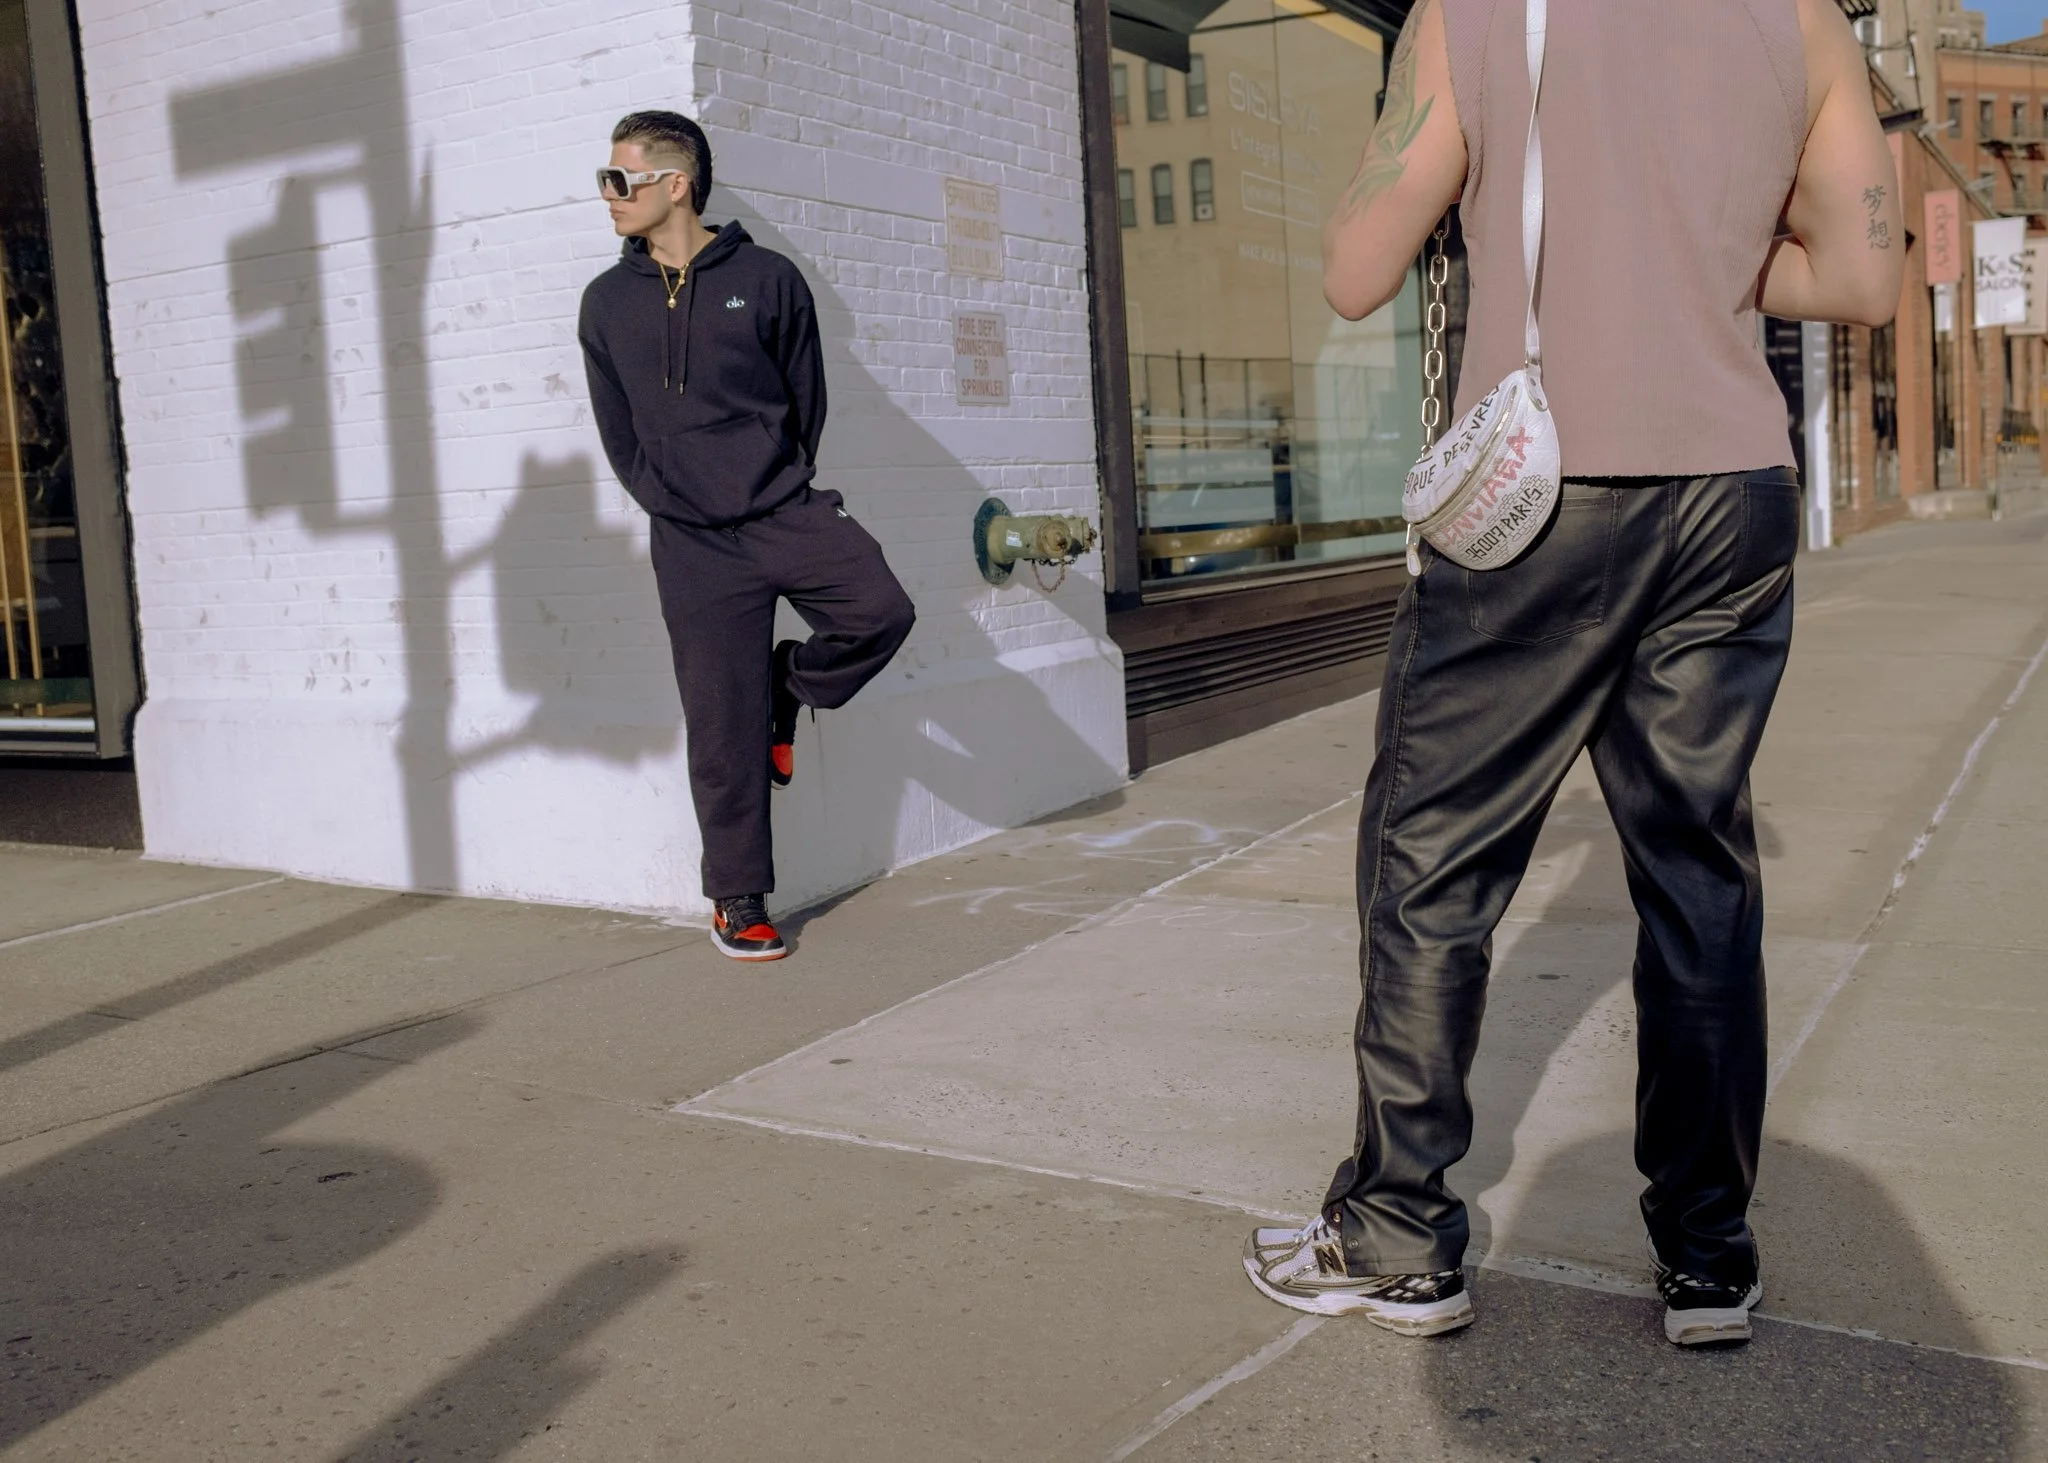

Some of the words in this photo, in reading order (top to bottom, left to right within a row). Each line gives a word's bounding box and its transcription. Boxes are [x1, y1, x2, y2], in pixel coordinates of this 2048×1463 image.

[1862, 184, 1893, 250] 梦想
[958, 316, 975, 336] FIRE
[956, 337, 1004, 358] CONNECTION
[973, 358, 989, 377] FOR
[961, 378, 1004, 397] SPRINKLER
[1443, 442, 1459, 468] DE
[1465, 525, 1508, 560] 75007
[1500, 486, 1544, 531] PARIS
